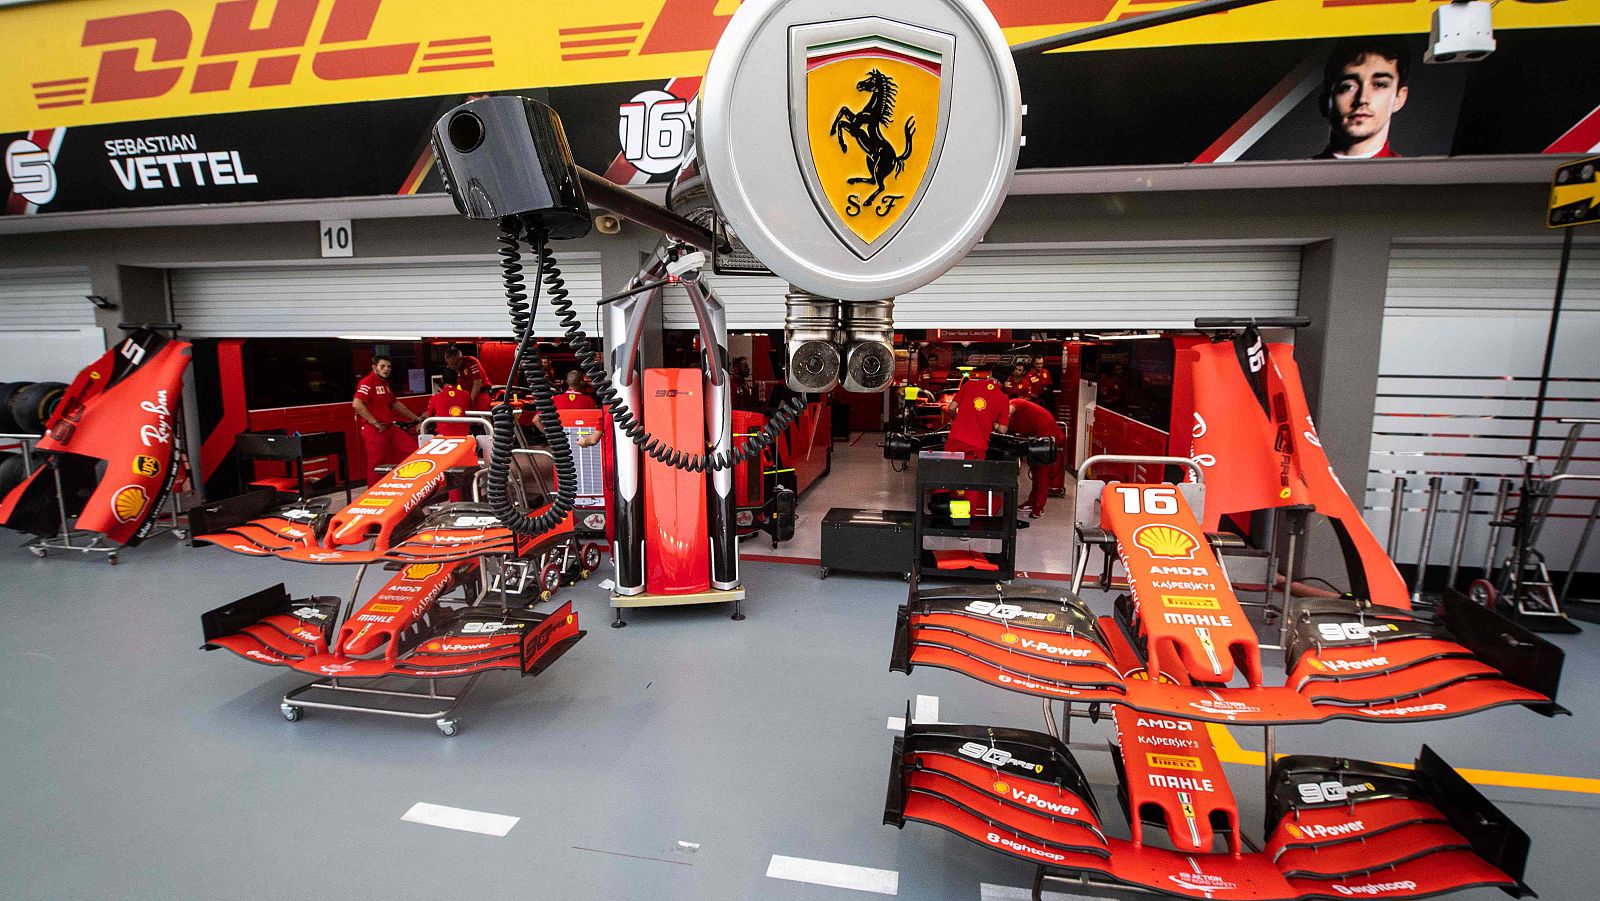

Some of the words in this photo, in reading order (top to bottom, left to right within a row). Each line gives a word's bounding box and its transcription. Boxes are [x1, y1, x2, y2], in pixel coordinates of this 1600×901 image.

[81, 0, 420, 104] DHL
[619, 98, 687, 160] 16
[104, 134, 197, 156] SEBASTIAN
[12, 151, 52, 195] 5
[109, 151, 258, 191] VETTEL
[323, 227, 349, 249] 10
[121, 338, 146, 365] 5
[1247, 336, 1265, 373] 16
[416, 437, 466, 455] 16
[1116, 487, 1179, 515] 16
[1150, 566, 1192, 576] AMD
[1152, 581, 1210, 590] KASPERSKY
[357, 614, 395, 622] MAHLE
[1164, 613, 1233, 627] MAHLE
[441, 642, 491, 651] V-Power
[1020, 638, 1092, 657] V-Power
[1322, 655, 1389, 672] V-Power
[1136, 718, 1177, 729] AMD
[1138, 735, 1193, 748] KASPERSKY
[1152, 756, 1198, 768] PIRELLI
[1148, 774, 1215, 792] MAHLE
[1011, 788, 1080, 816] V-Power
[1301, 820, 1364, 838] V-Power
[1000, 838, 1066, 861] eightcap
